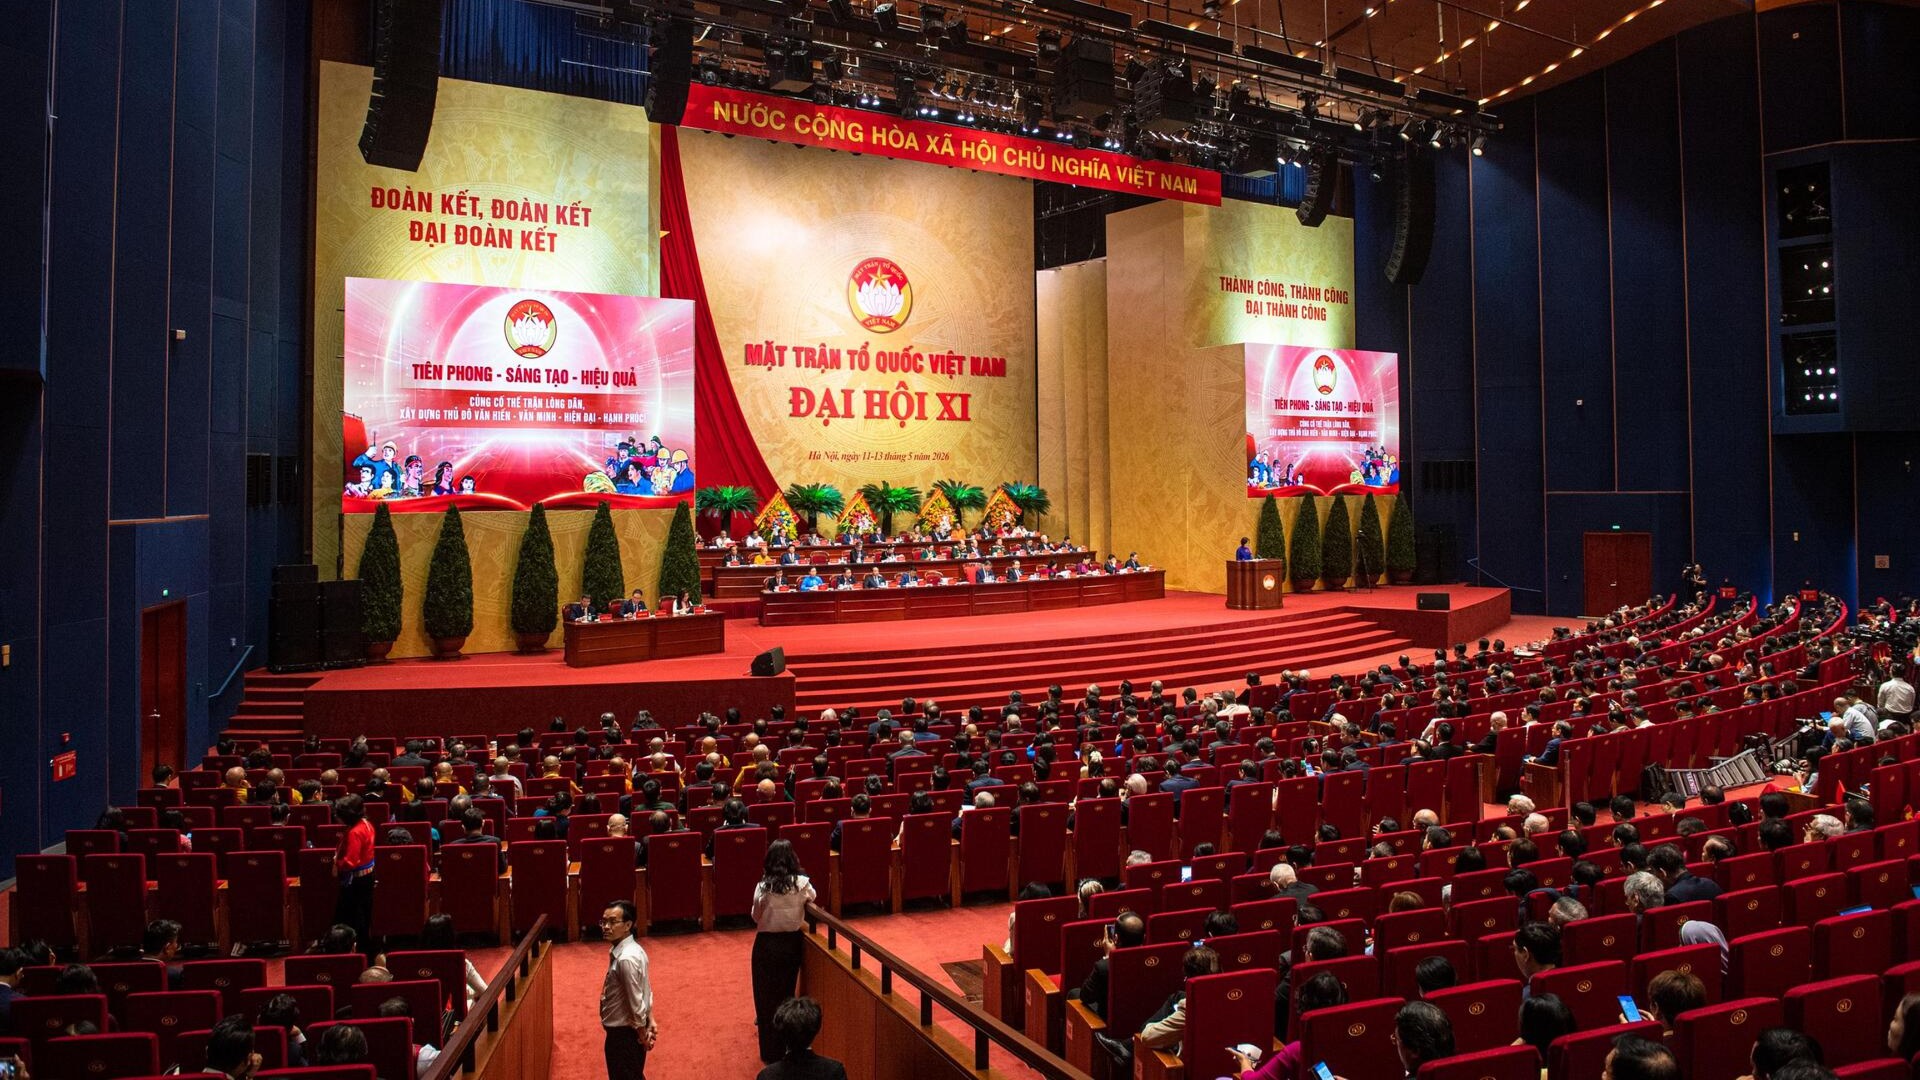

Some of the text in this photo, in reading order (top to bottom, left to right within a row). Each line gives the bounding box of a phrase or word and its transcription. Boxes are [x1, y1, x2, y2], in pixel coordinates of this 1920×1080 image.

[713, 101, 1198, 195] NƯỚC CỘNG HÒA XÃ HỘI CHỦ NGHĨA VIỆT NAM
[370, 185, 592, 227] ĐOÀN KẾT, ĐOÀN KẾT
[409, 220, 558, 252] ĐẠI ĐOÀN KẾT
[1219, 275, 1349, 304] THÀNH CÔNG, THÀNH CÔNG
[1245, 300, 1327, 321] ĐẠI THÀNH CÔNG
[744, 340, 1007, 379] MẶT TRẬN TỔ QUỐC VIỆT NAM
[412, 363, 443, 380] TIÊN
[447, 365, 493, 382] PHONG
[506, 364, 541, 384] SÁNG
[545, 369, 569, 388] TẠO
[581, 367, 609, 389] HIỆU
[612, 367, 637, 387] QUẢ
[789, 380, 971, 428] ĐẠI HỘI XI
[808, 450, 950, 464] Hà Nội, ngày 11-13 tháng 5 năm 2026
